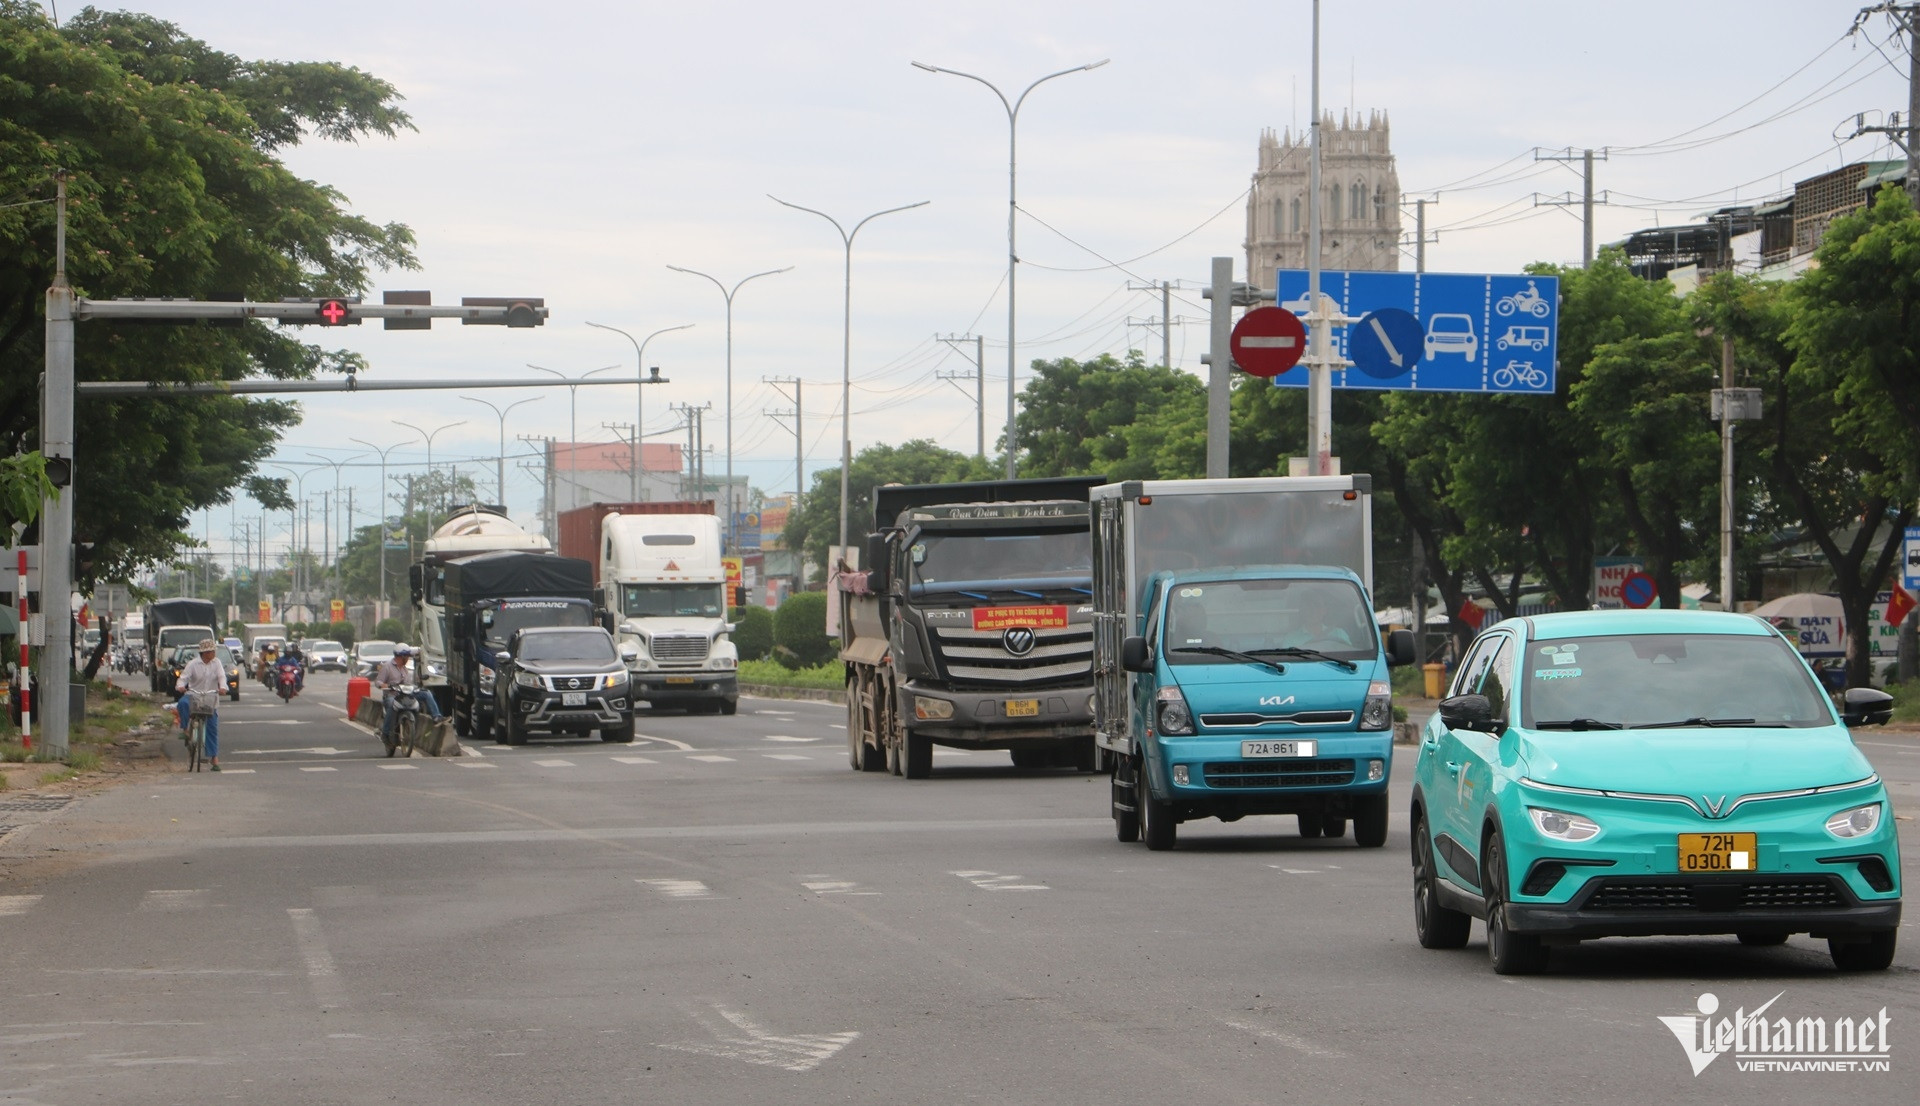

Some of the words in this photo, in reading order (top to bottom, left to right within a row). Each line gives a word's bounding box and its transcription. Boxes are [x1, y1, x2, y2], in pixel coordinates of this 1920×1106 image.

[1260, 695, 1295, 705] KIA
[1248, 743, 1298, 754] 72A-861.
[1701, 835, 1734, 851] 72H
[1687, 853, 1732, 869] 030.
